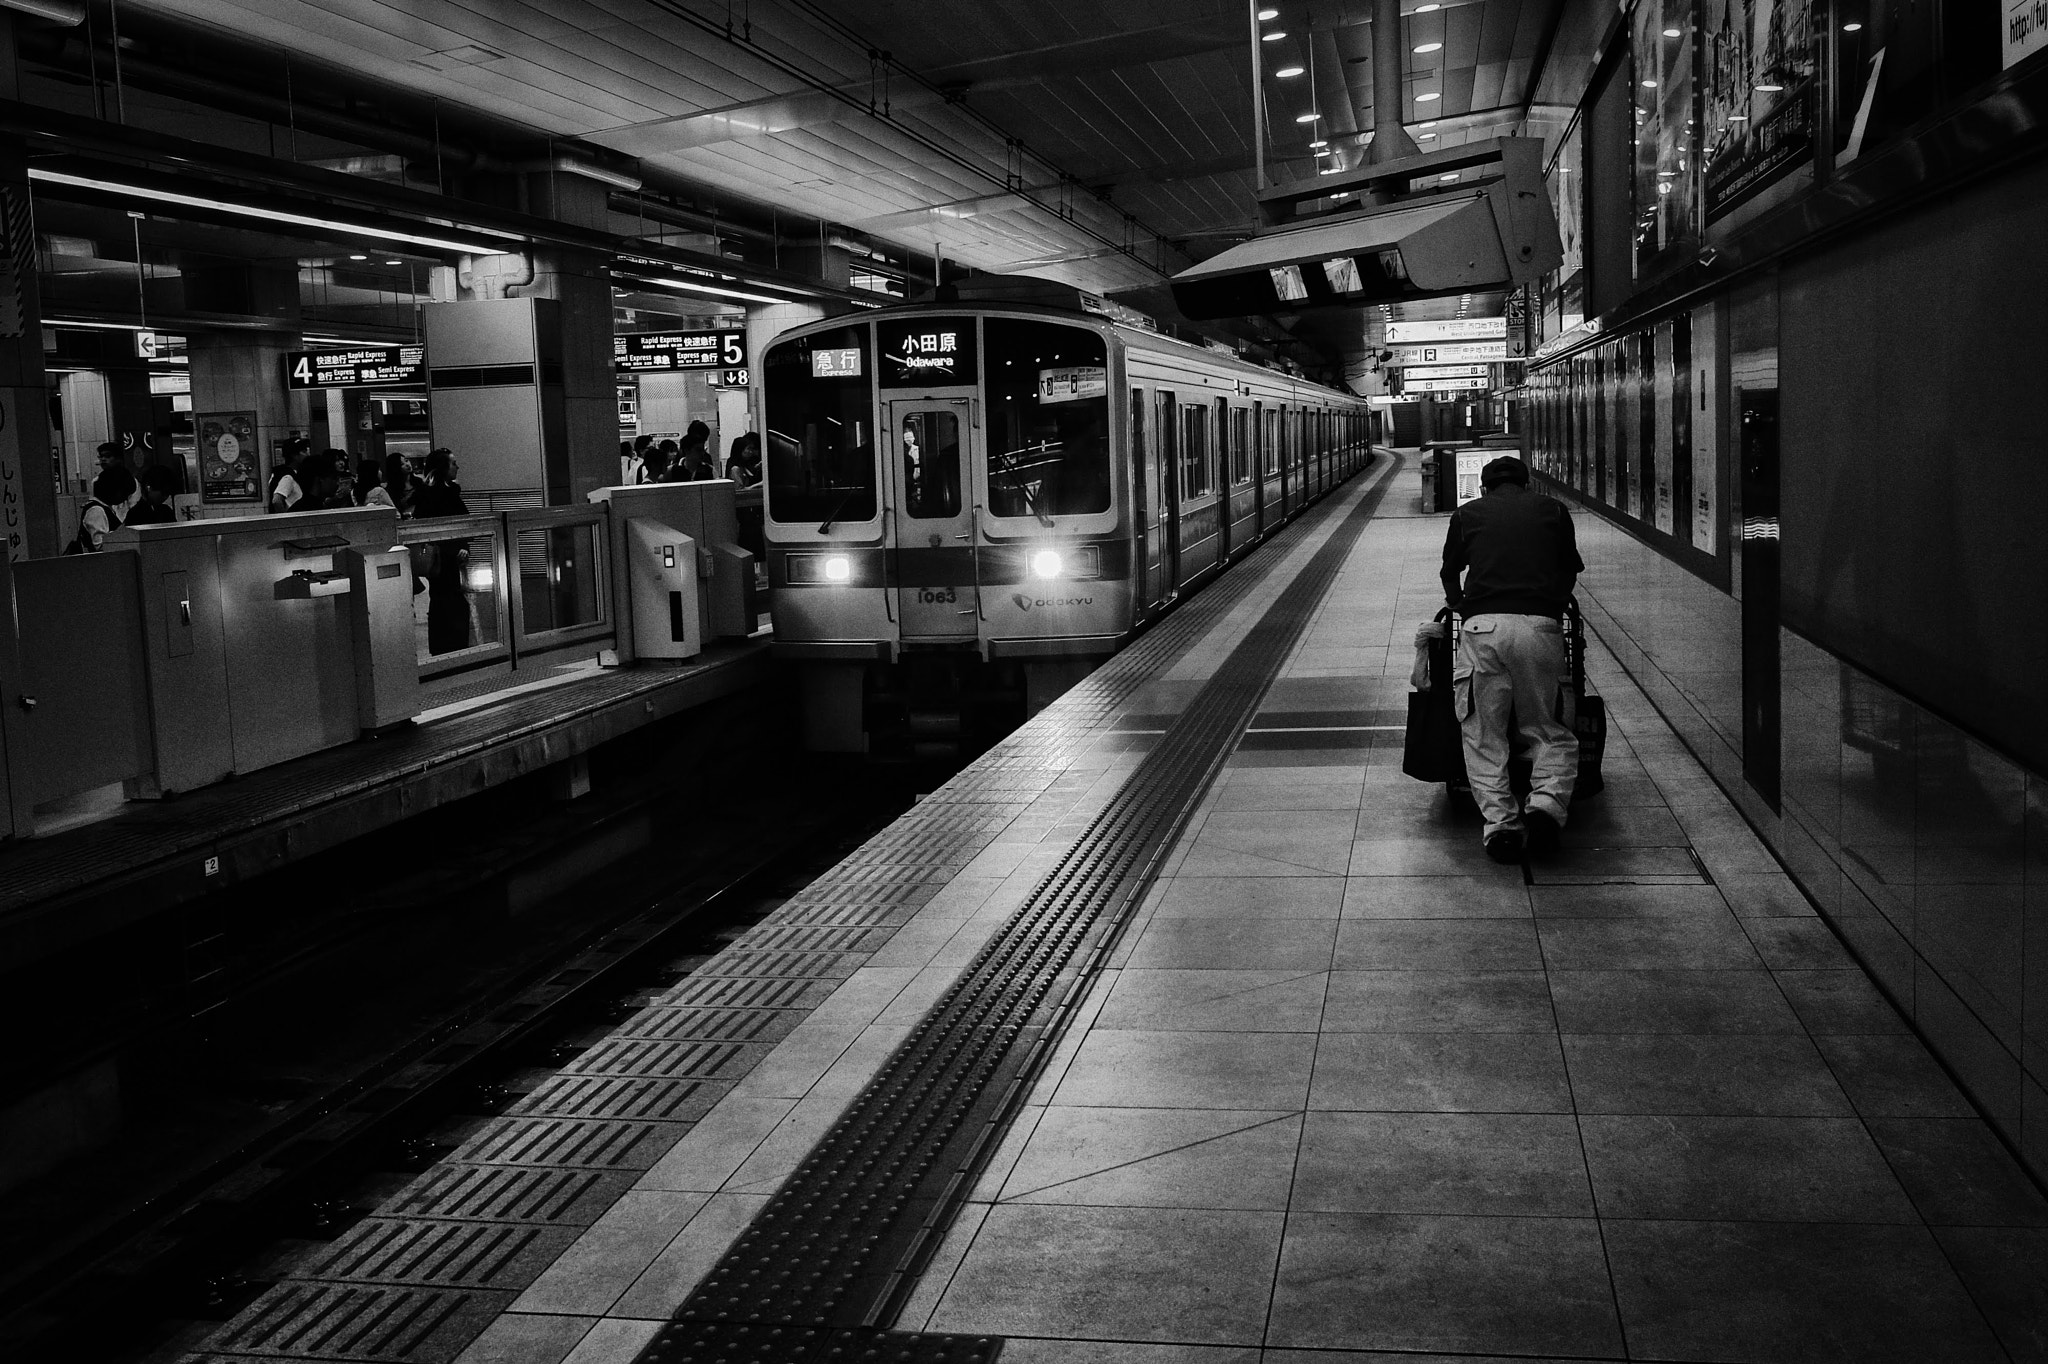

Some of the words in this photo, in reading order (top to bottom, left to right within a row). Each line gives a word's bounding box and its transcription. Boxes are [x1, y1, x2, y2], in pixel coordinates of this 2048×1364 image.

[641, 337, 658, 345] Rapid
[660, 336, 682, 344] Express
[684, 336, 717, 347] 快速急行
[902, 333, 957, 354] 小田原
[724, 335, 743, 364] 5
[316, 355, 347, 365] 快速急行
[365, 351, 387, 359] Express
[629, 354, 652, 363] Express
[676, 352, 700, 360] Express
[701, 353, 718, 363] 急行
[816, 351, 857, 370] 急行
[906, 356, 954, 368] Odawara
[293, 357, 313, 384] 4
[333, 369, 355, 377] Express
[378, 366, 393, 374] Semi
[393, 366, 415, 374] Express
[317, 371, 333, 381] 急行
[737, 369, 749, 385] 8
[1458, 460, 1480, 469] RES
[918, 591, 957, 604] 1063
